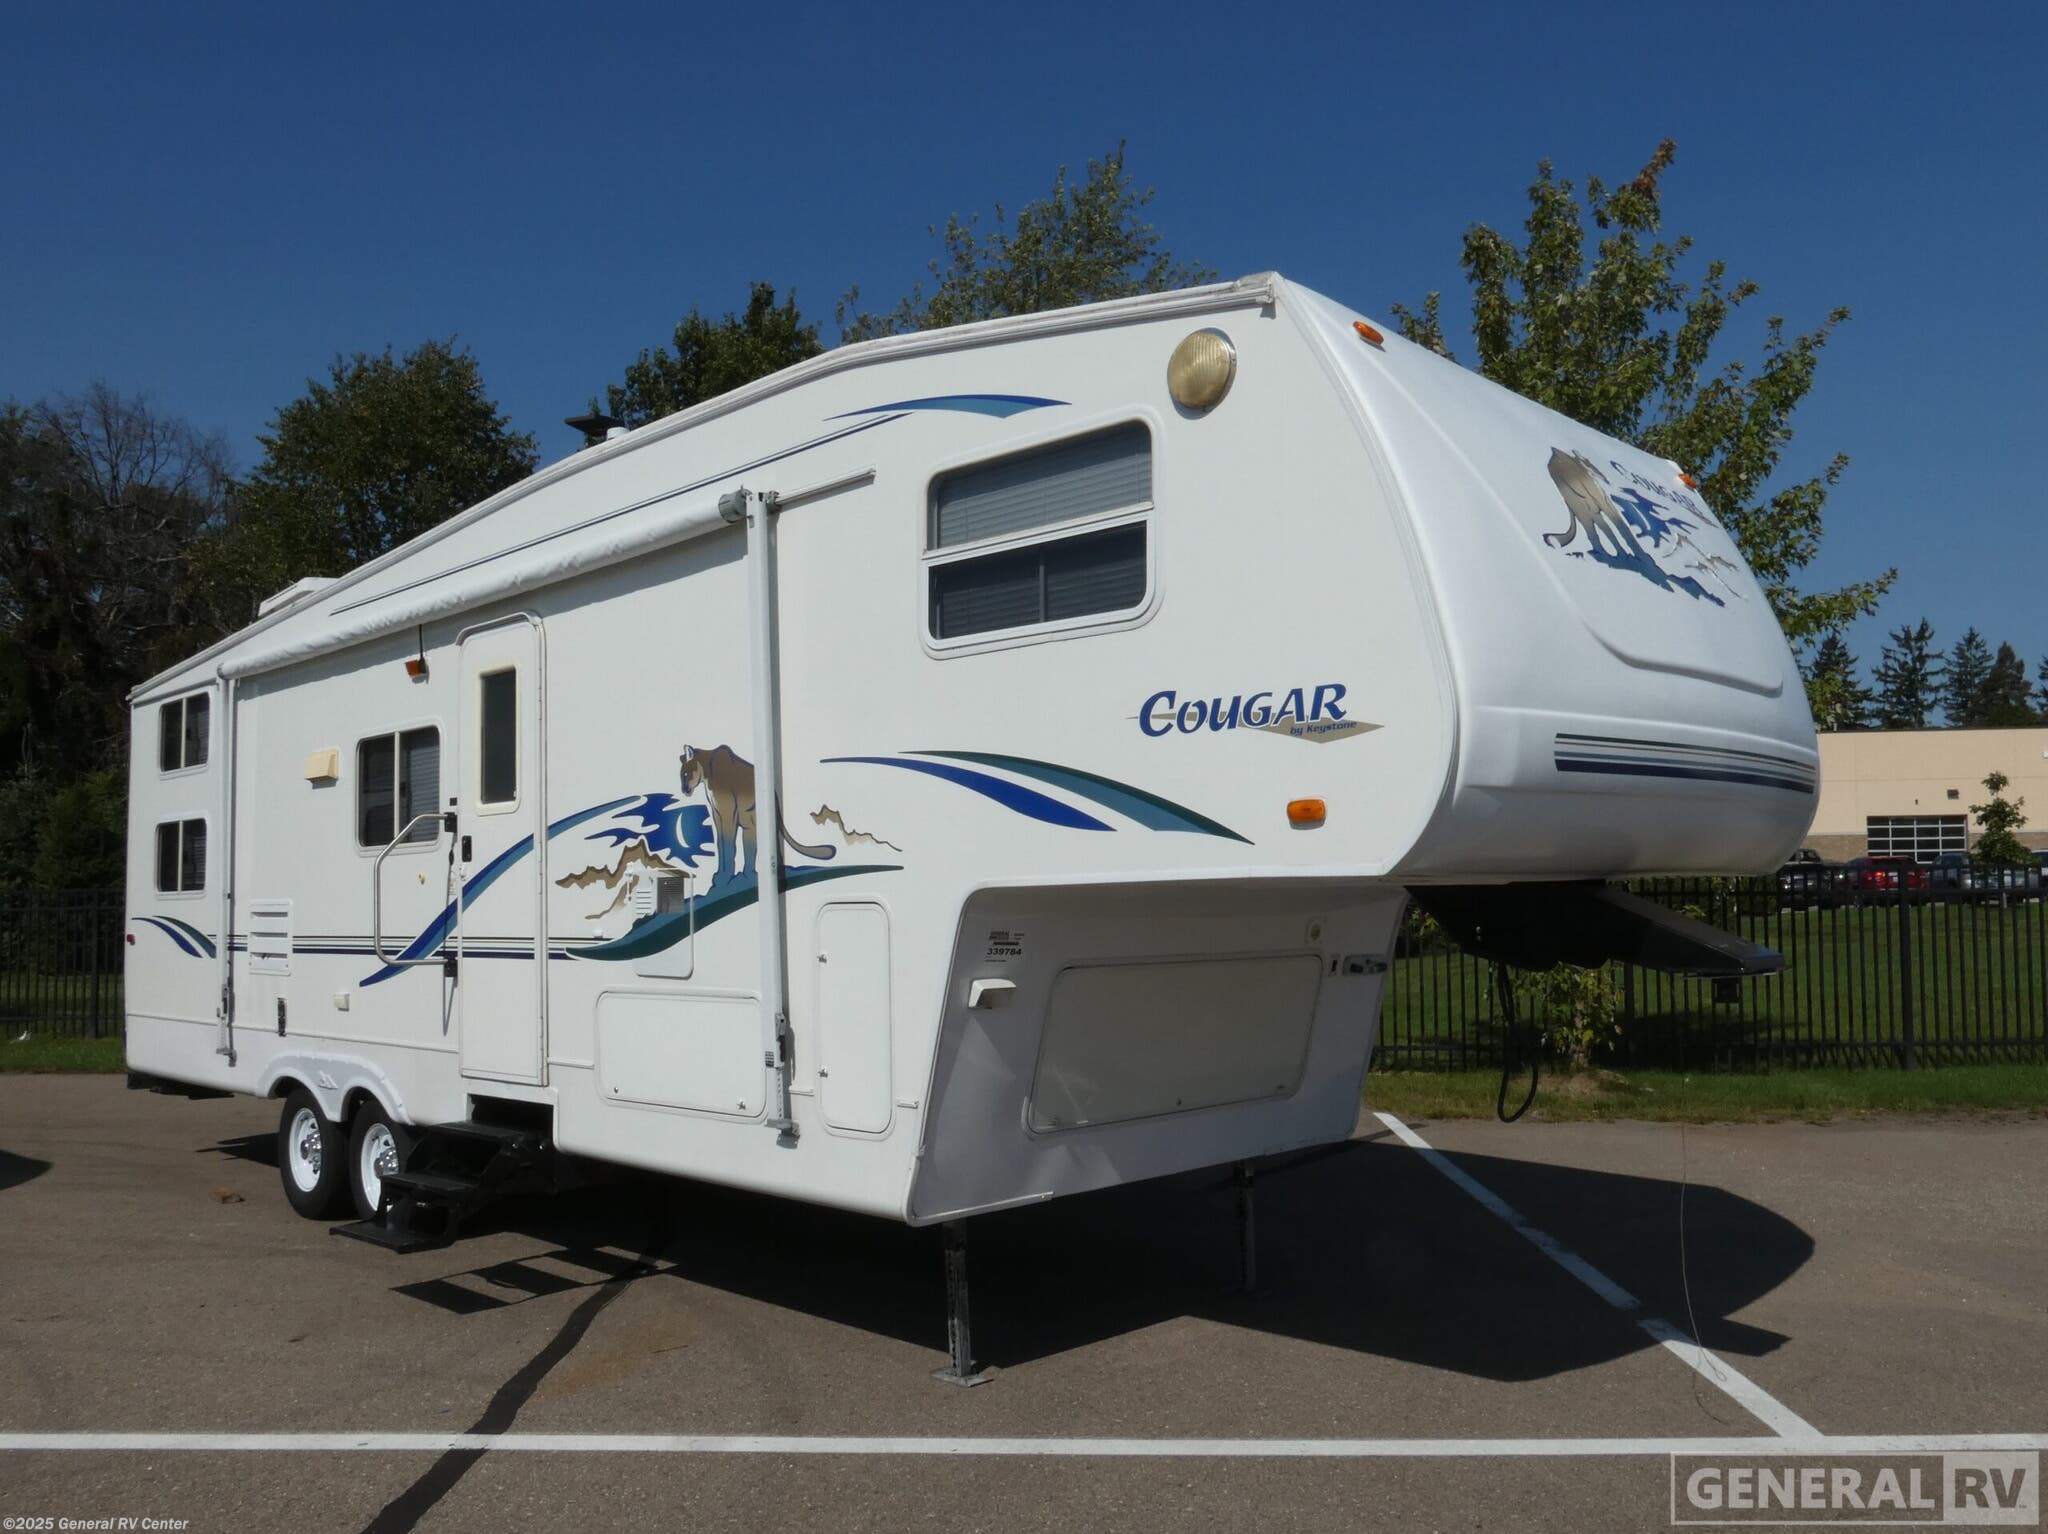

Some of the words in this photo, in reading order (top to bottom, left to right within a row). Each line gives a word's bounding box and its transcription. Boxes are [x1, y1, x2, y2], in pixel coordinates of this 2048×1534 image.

[1138, 683, 1348, 737] COUGAR
[1289, 726, 1304, 736] by
[1306, 721, 1358, 734] Keystone
